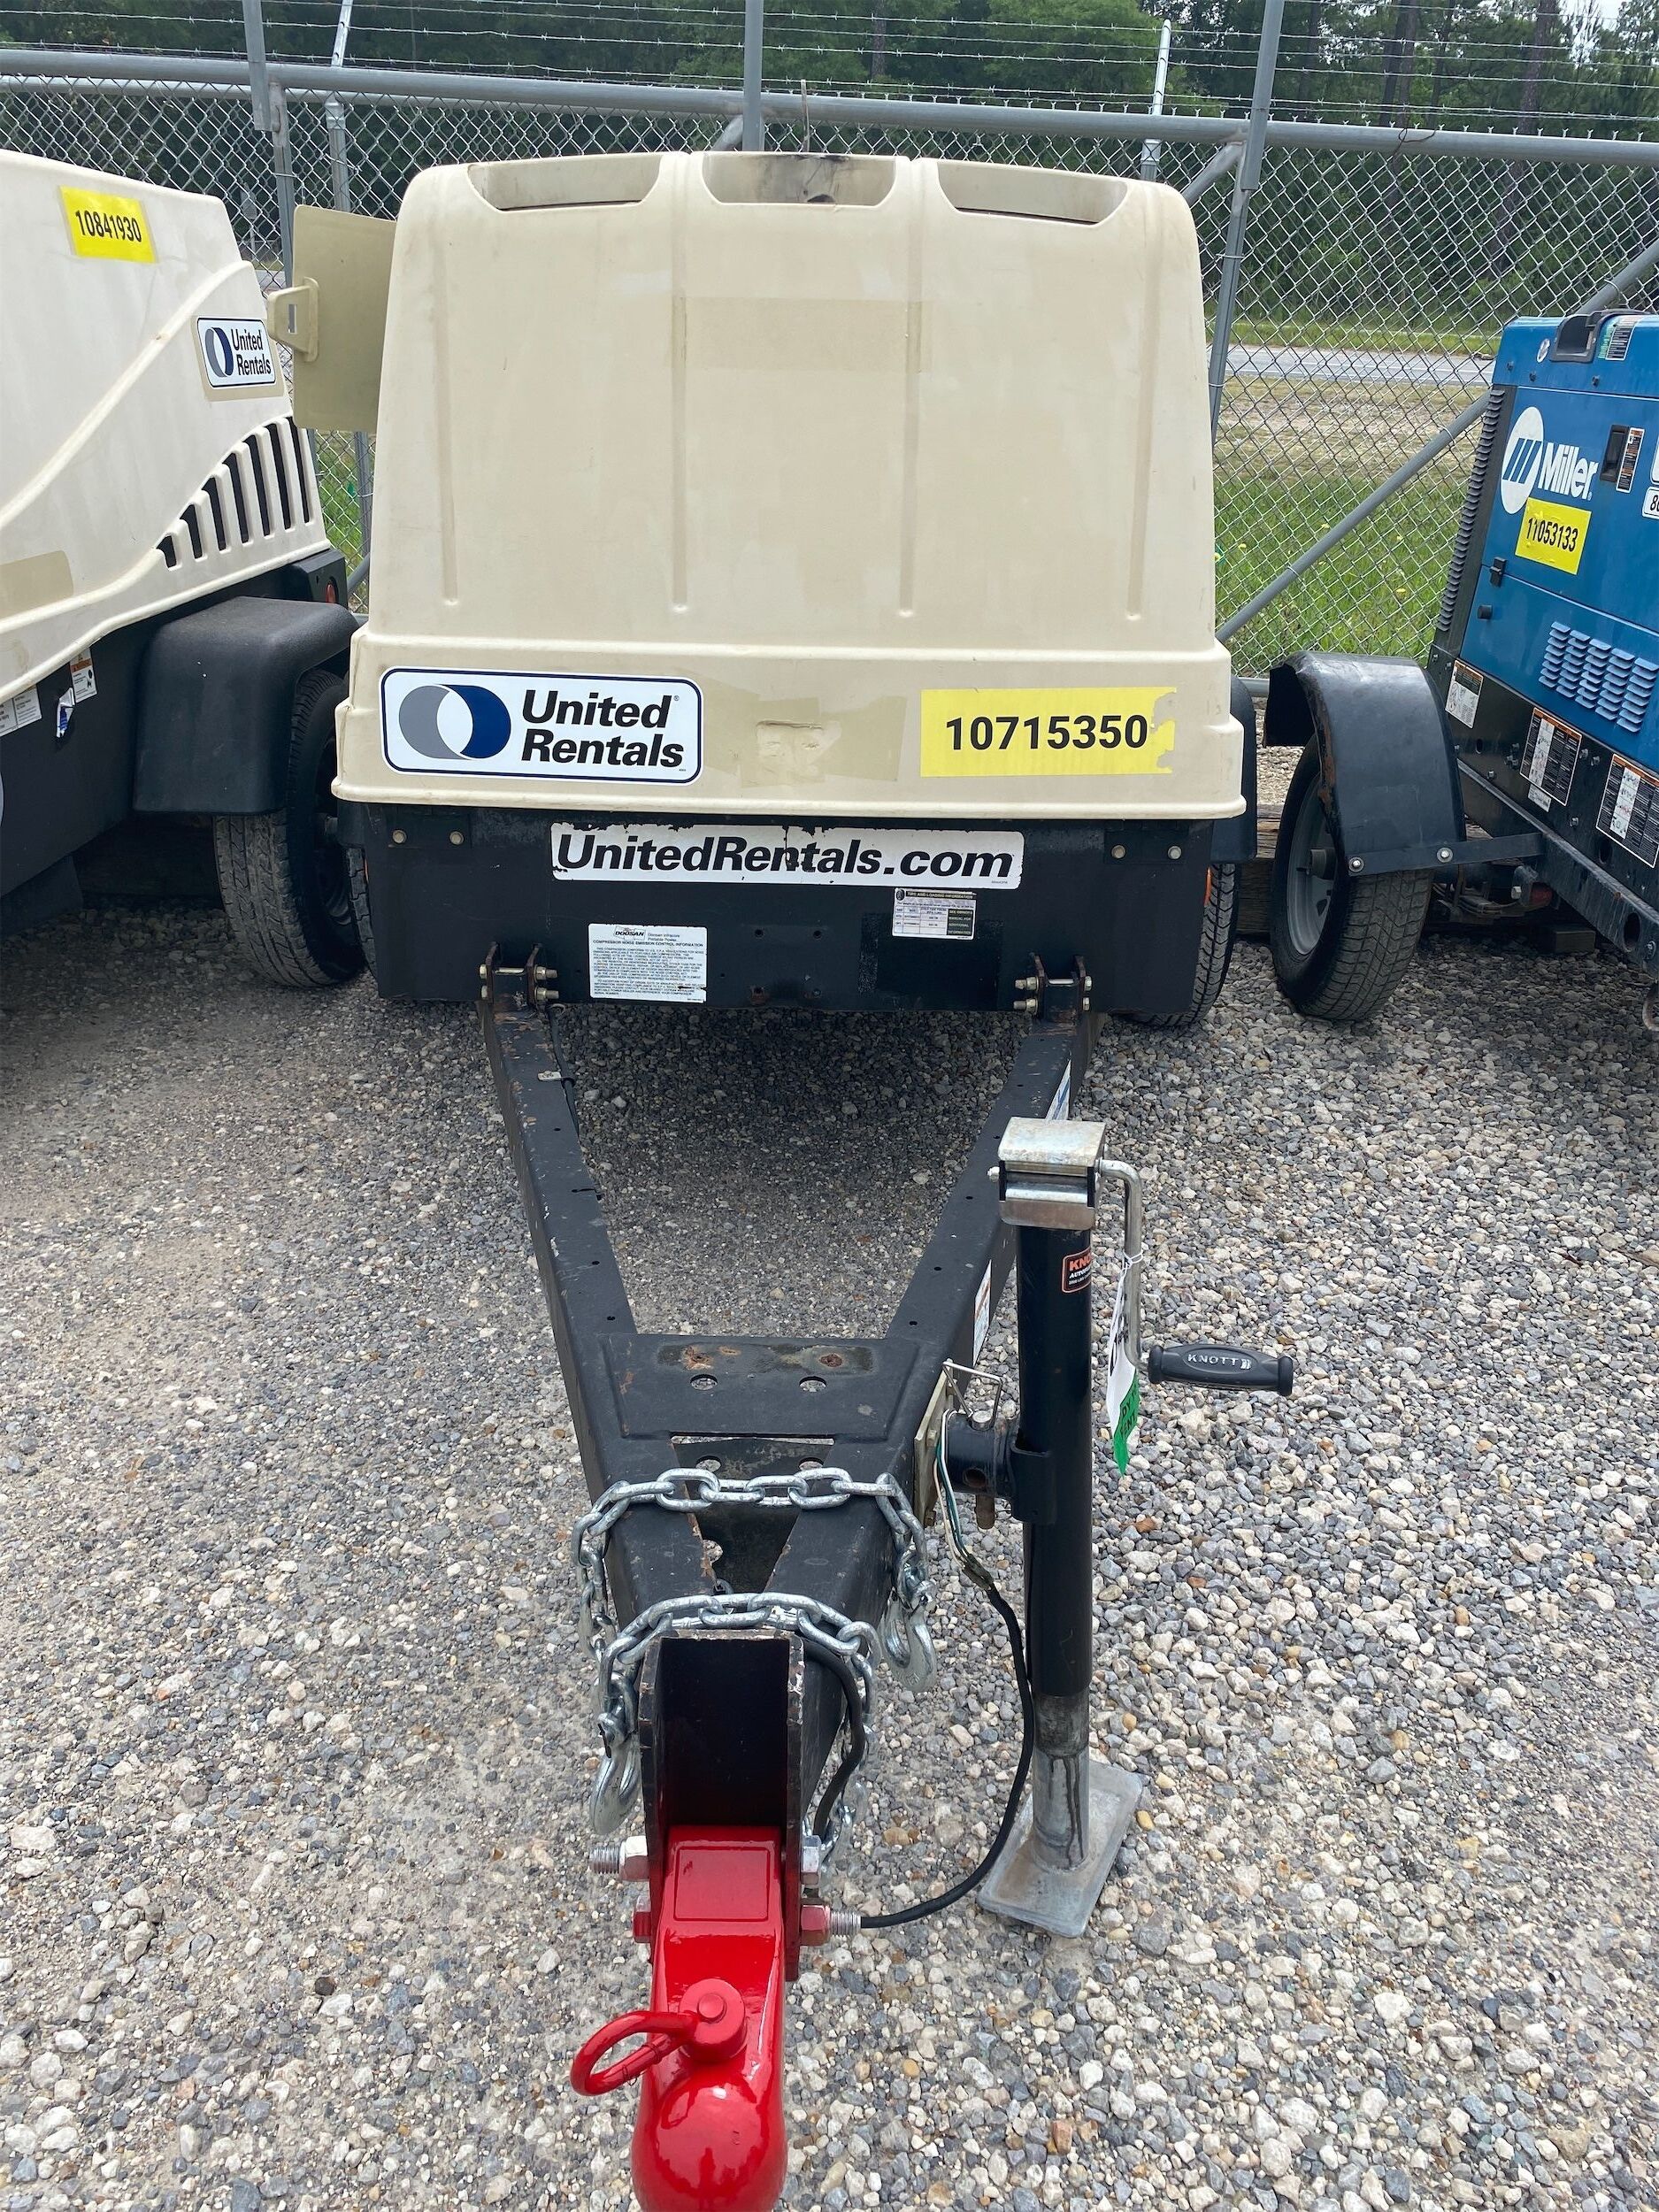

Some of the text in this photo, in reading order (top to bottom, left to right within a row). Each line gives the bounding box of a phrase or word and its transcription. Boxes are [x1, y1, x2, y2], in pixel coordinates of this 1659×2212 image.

[75, 209, 142, 243] 10841930
[231, 328, 264, 351] United
[235, 353, 272, 376] Rentals
[1537, 442, 1599, 500] Miller
[1525, 517, 1578, 552] 11053133
[521, 688, 673, 729] United
[520, 727, 685, 768] Rentals
[946, 713, 1148, 751] 10715350
[557, 833, 1015, 879] UnitedRentals.com
[1187, 1354, 1239, 1366] KNOTT
